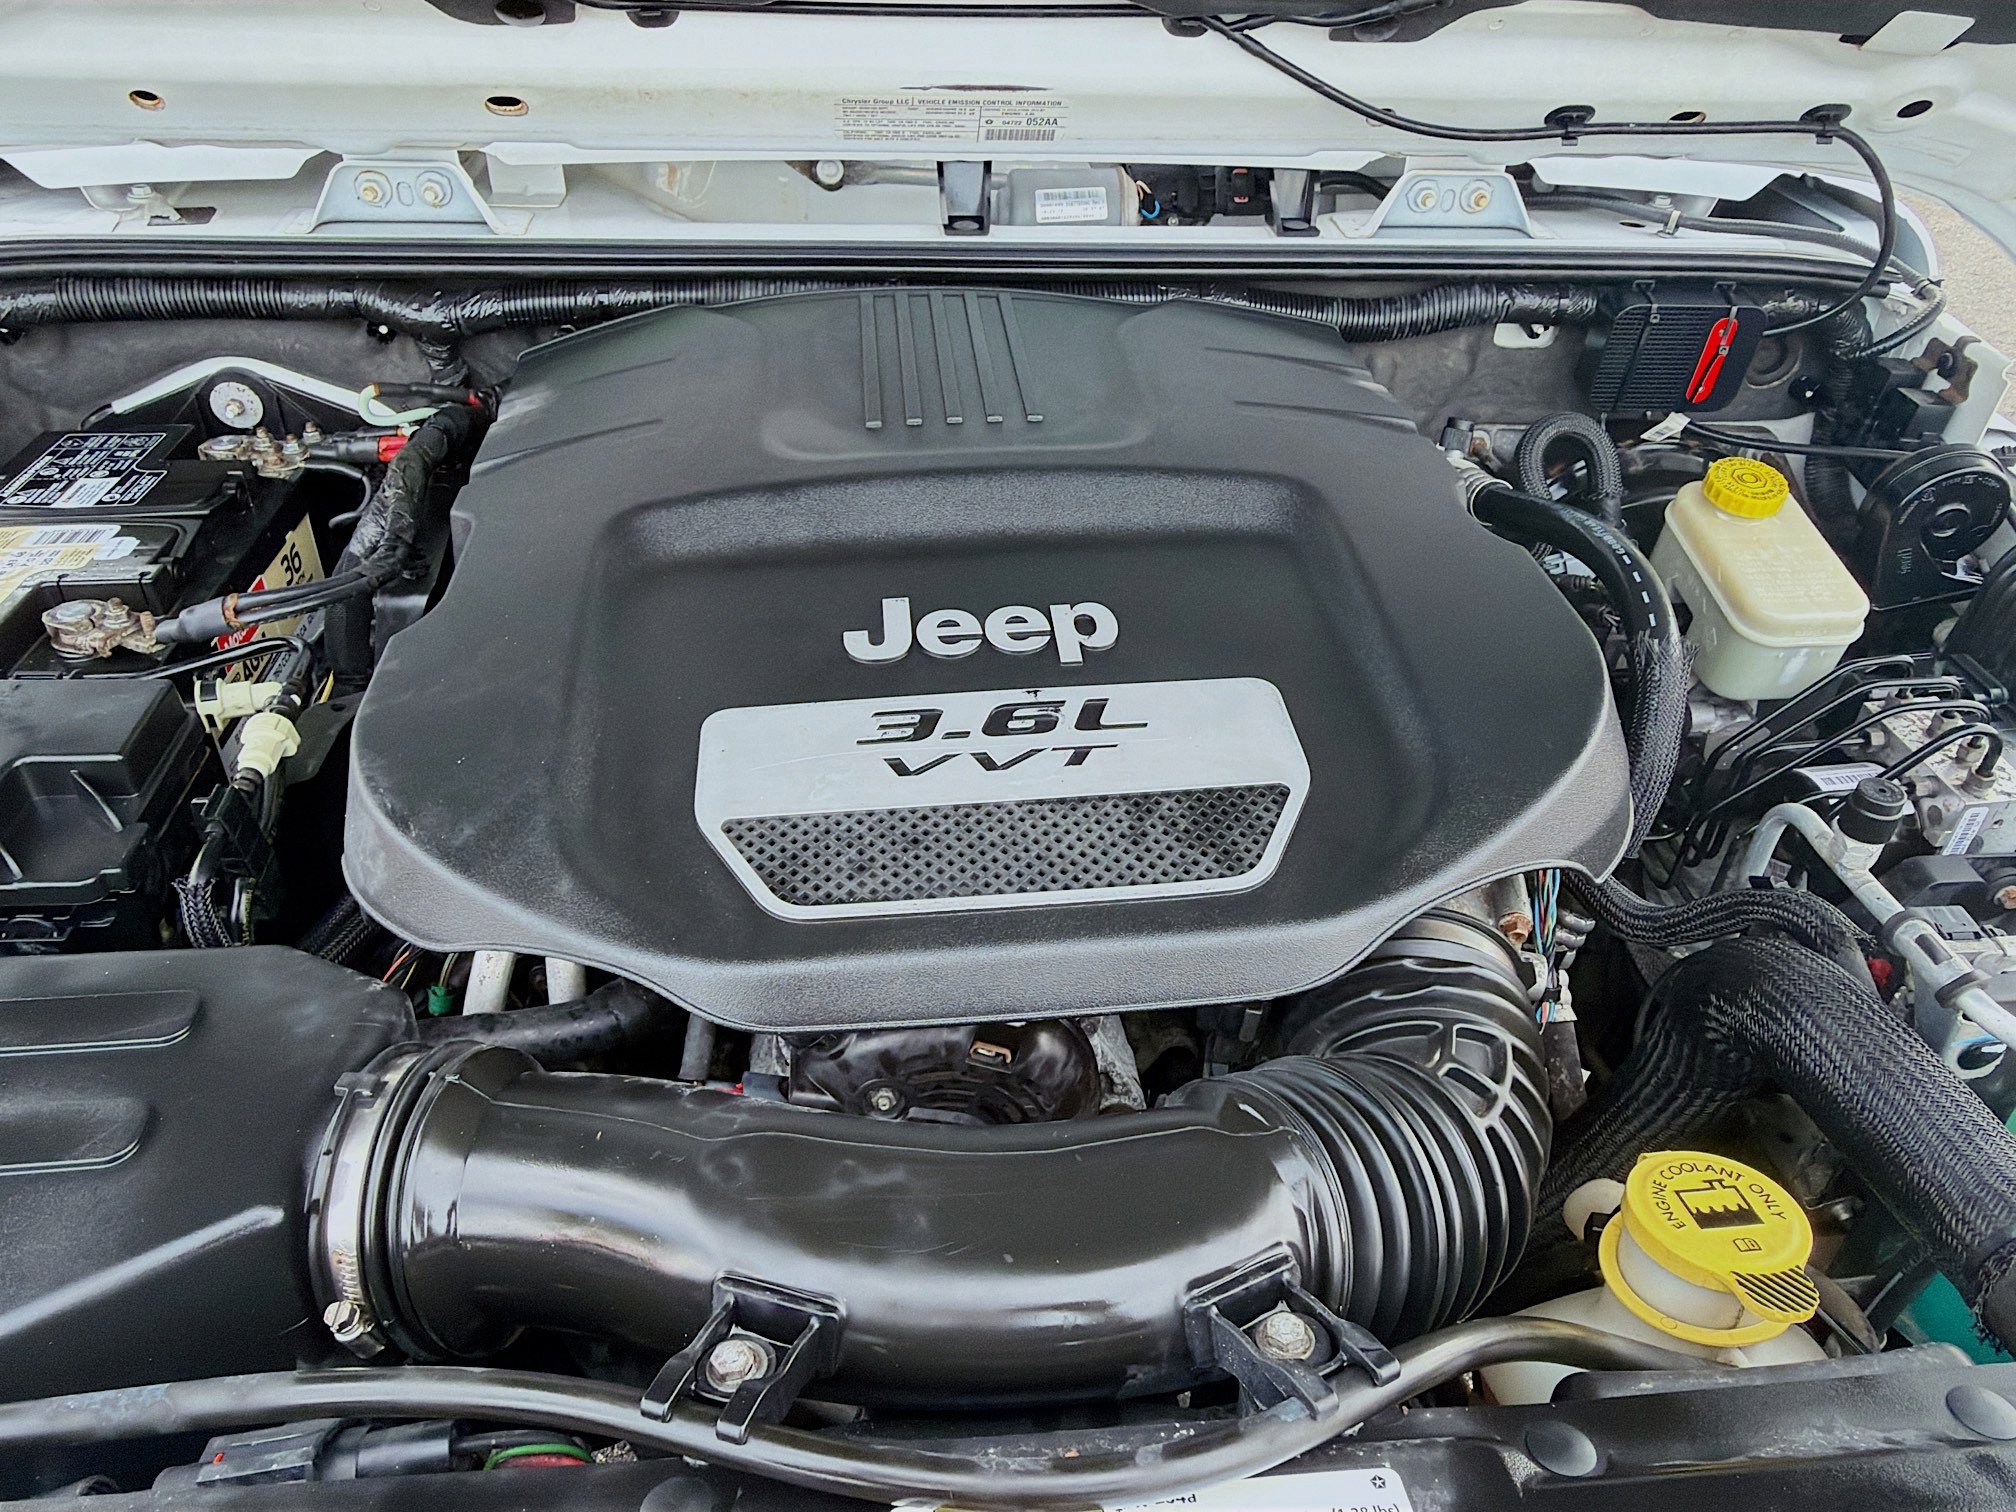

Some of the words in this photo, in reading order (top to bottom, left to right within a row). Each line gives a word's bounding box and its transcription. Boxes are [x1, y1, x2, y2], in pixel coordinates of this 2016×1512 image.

[842, 98, 871, 107] Chrysler
[873, 99, 894, 107] Group
[896, 98, 910, 106] LLC
[948, 99, 981, 107] EMISSION
[1025, 117, 1059, 127] 052AA
[280, 541, 303, 587] 36
[843, 596, 1119, 667] Jeep
[856, 697, 1149, 746] 3.6L
[882, 743, 1119, 778] VVT
[1660, 1162, 1746, 1182] COOLANT
[1651, 1178, 1687, 1231] ENGINE
[1749, 1183, 1787, 1220] ONLY
